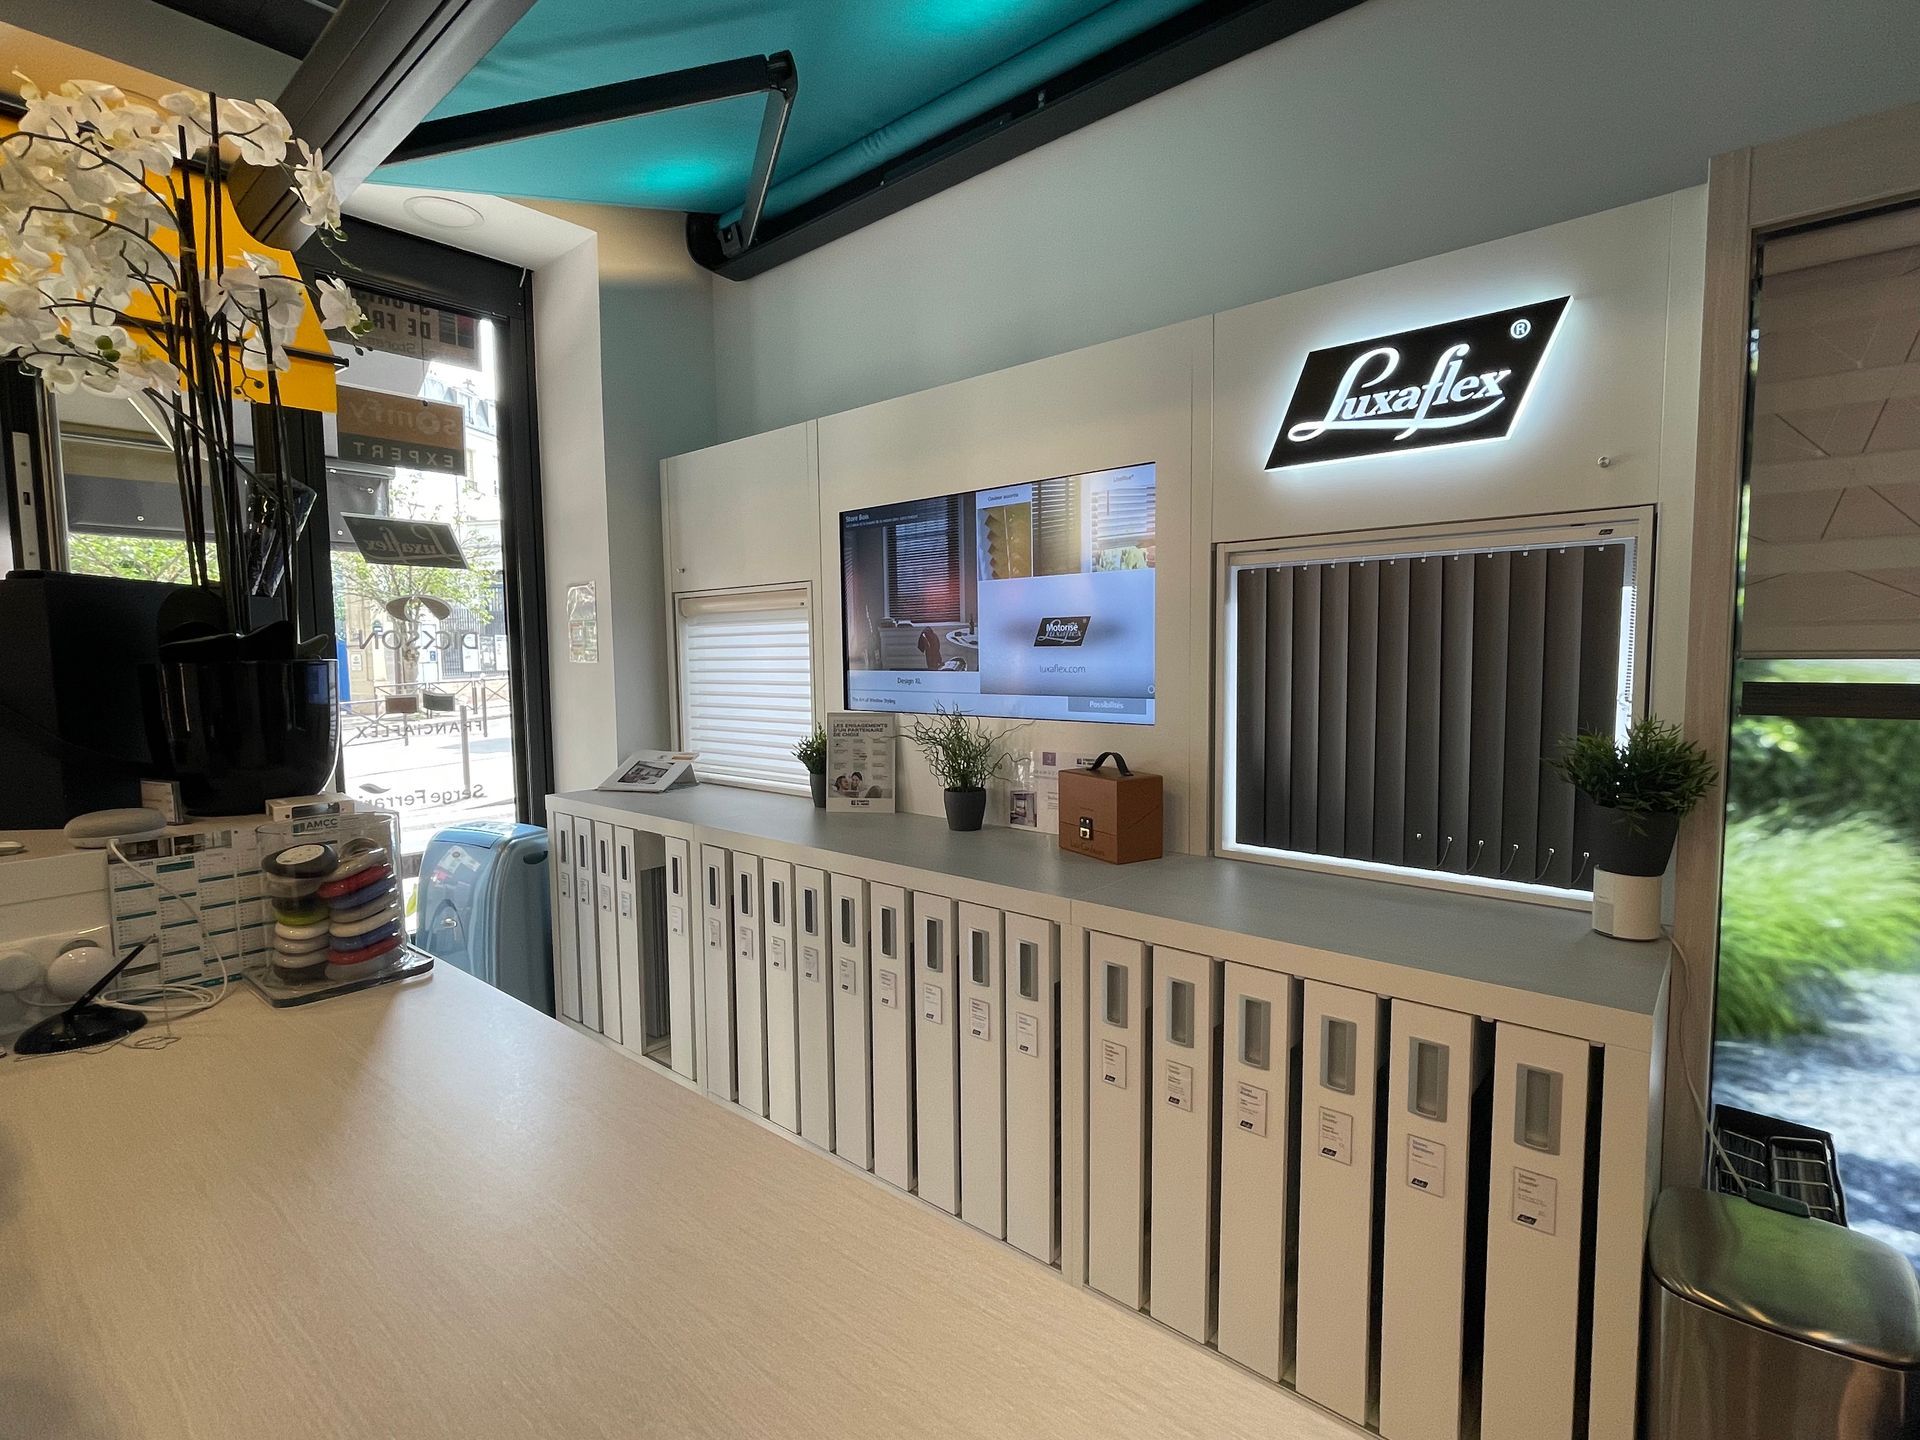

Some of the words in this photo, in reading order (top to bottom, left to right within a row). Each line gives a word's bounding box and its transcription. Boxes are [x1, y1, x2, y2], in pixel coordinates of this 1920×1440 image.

[1288, 344, 1511, 441] Luxaflex
[1046, 622, 1079, 632] Motorisé
[1039, 664, 1086, 674] luxaflex.com
[1089, 700, 1124, 710] Possibilités
[306, 818, 338, 829] AMCC
